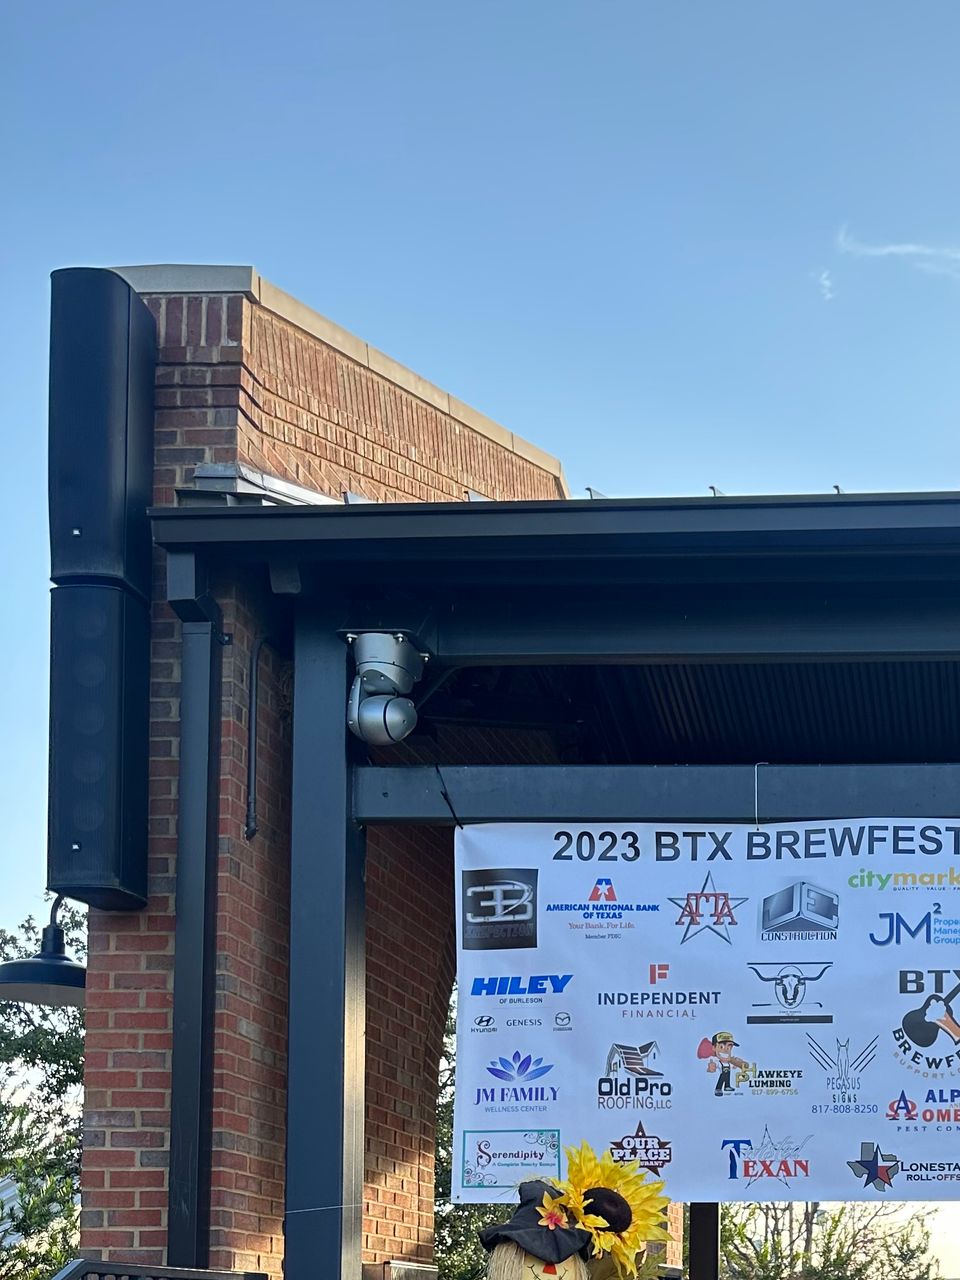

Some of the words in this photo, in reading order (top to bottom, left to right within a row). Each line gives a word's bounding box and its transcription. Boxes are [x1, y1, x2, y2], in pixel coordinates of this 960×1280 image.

[553, 831, 640, 862] 2023
[655, 831, 733, 861] BTX
[636, 904, 660, 912] BANK
[761, 931, 837, 941] CONSTRUCTION
[470, 974, 574, 996] HILEY
[598, 991, 721, 1005] INDEPENDENT
[622, 1009, 697, 1018] FINANCIAL
[506, 1019, 543, 1027] GENESIS
[597, 1077, 630, 1096] Old
[634, 1078, 672, 1096] Pro
[826, 1077, 861, 1091] PEGASUS
[473, 1088, 495, 1106] JM
[501, 1086, 561, 1102] FAMILY
[832, 1094, 858, 1103] SIGNS
[811, 1104, 878, 1114] 817-808-8250
[622, 1137, 660, 1149] OUR
[476, 1140, 545, 1170] Serendipity
[612, 1149, 670, 1161] PLACE
